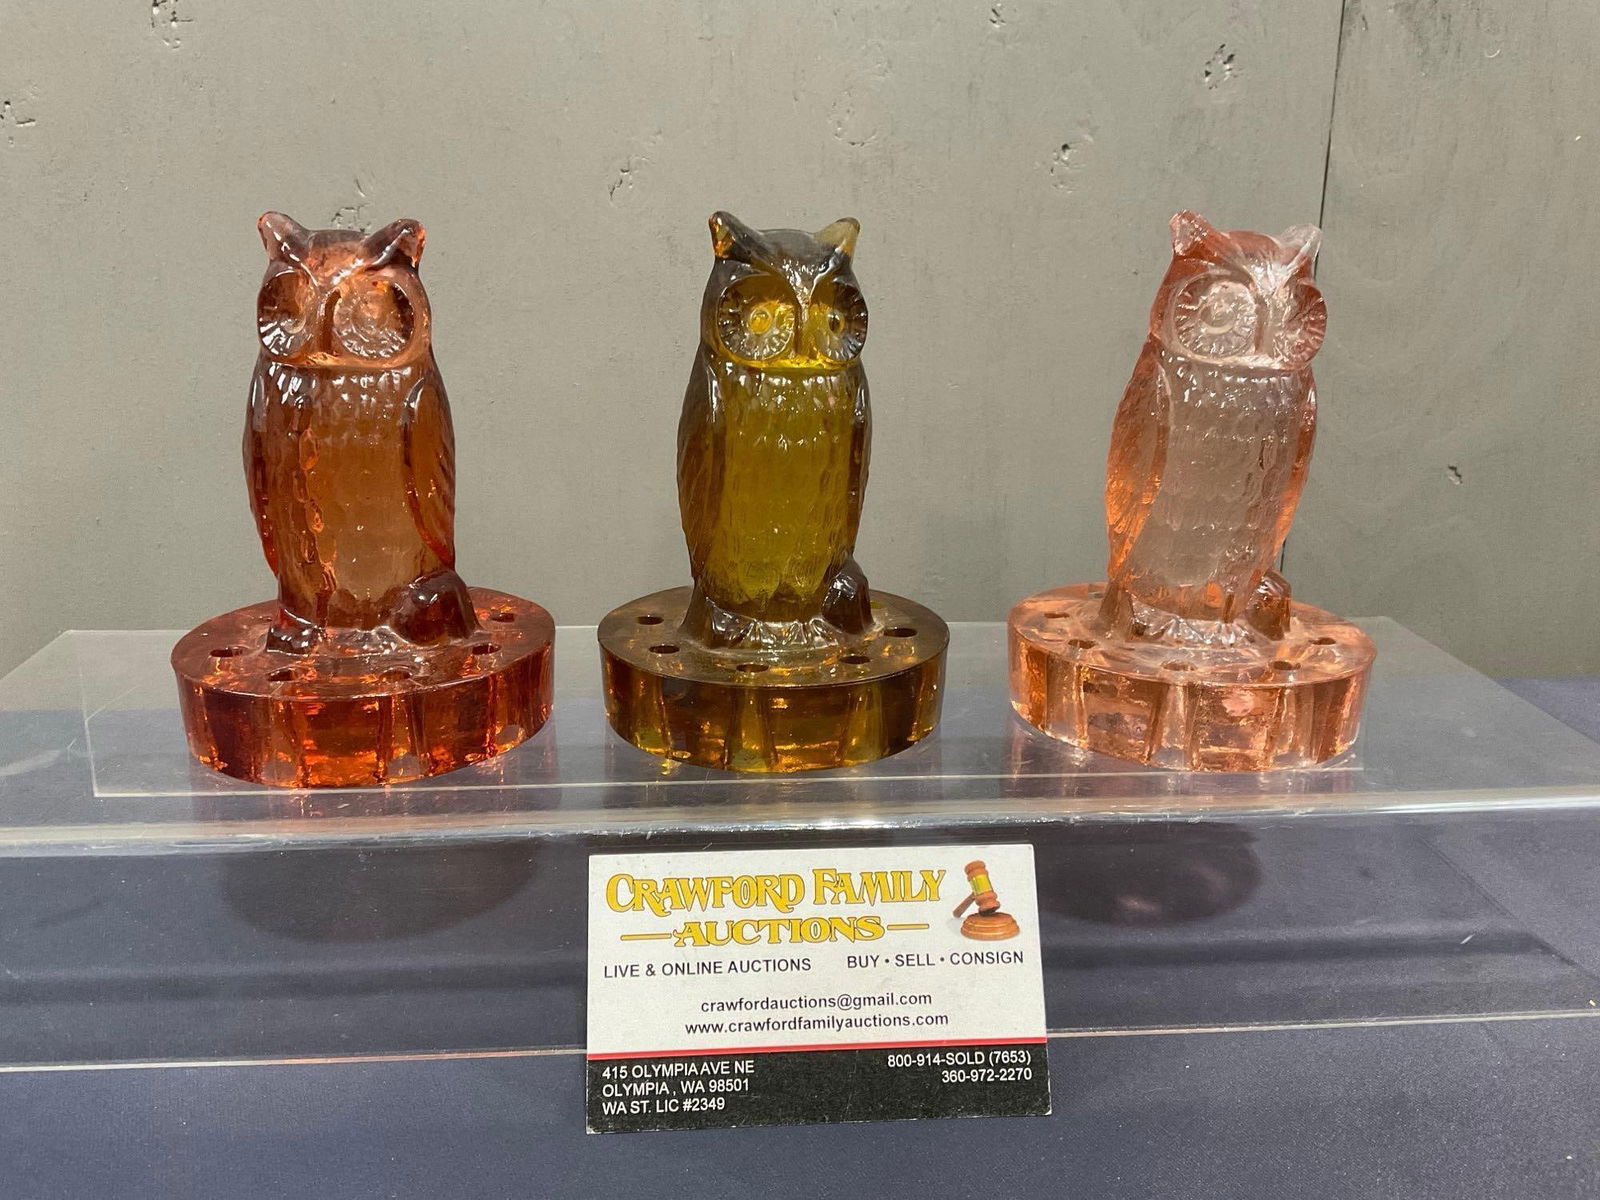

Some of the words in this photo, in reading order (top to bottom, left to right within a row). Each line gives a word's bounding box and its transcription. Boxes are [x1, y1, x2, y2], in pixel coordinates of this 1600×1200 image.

[605, 873, 805, 916] CRAWFORD
[812, 869, 946, 907] FAMILY
[674, 915, 885, 947] AUCTIONS
[603, 964, 640, 978] LIVE
[645, 964, 656, 977] &
[661, 960, 724, 977] ONLINE
[727, 958, 812, 973] AUCTIONS
[847, 955, 880, 969] BUY
[894, 953, 935, 967] SELL
[949, 951, 1025, 966] CONSIGN
[701, 993, 932, 1013] crawfordauctions@gmail.com
[685, 1014, 949, 1034] www.crawfordfamilyauctions.com
[887, 1052, 985, 1068] 800-914-SOLD
[988, 1050, 1032, 1067] (7653)
[602, 1066, 628, 1080] 415
[632, 1064, 699, 1078] OLYMPIA
[700, 1061, 731, 1076] AVE
[735, 1060, 755, 1075] NE
[941, 1069, 1032, 1083] 360-972-2270
[680, 1079, 705, 1094] WA
[708, 1077, 750, 1093] 98501
[602, 1101, 628, 1115] WA
[630, 1099, 652, 1114] ST.
[655, 1097, 679, 1113] LIC
[682, 1097, 725, 1112] #2349
